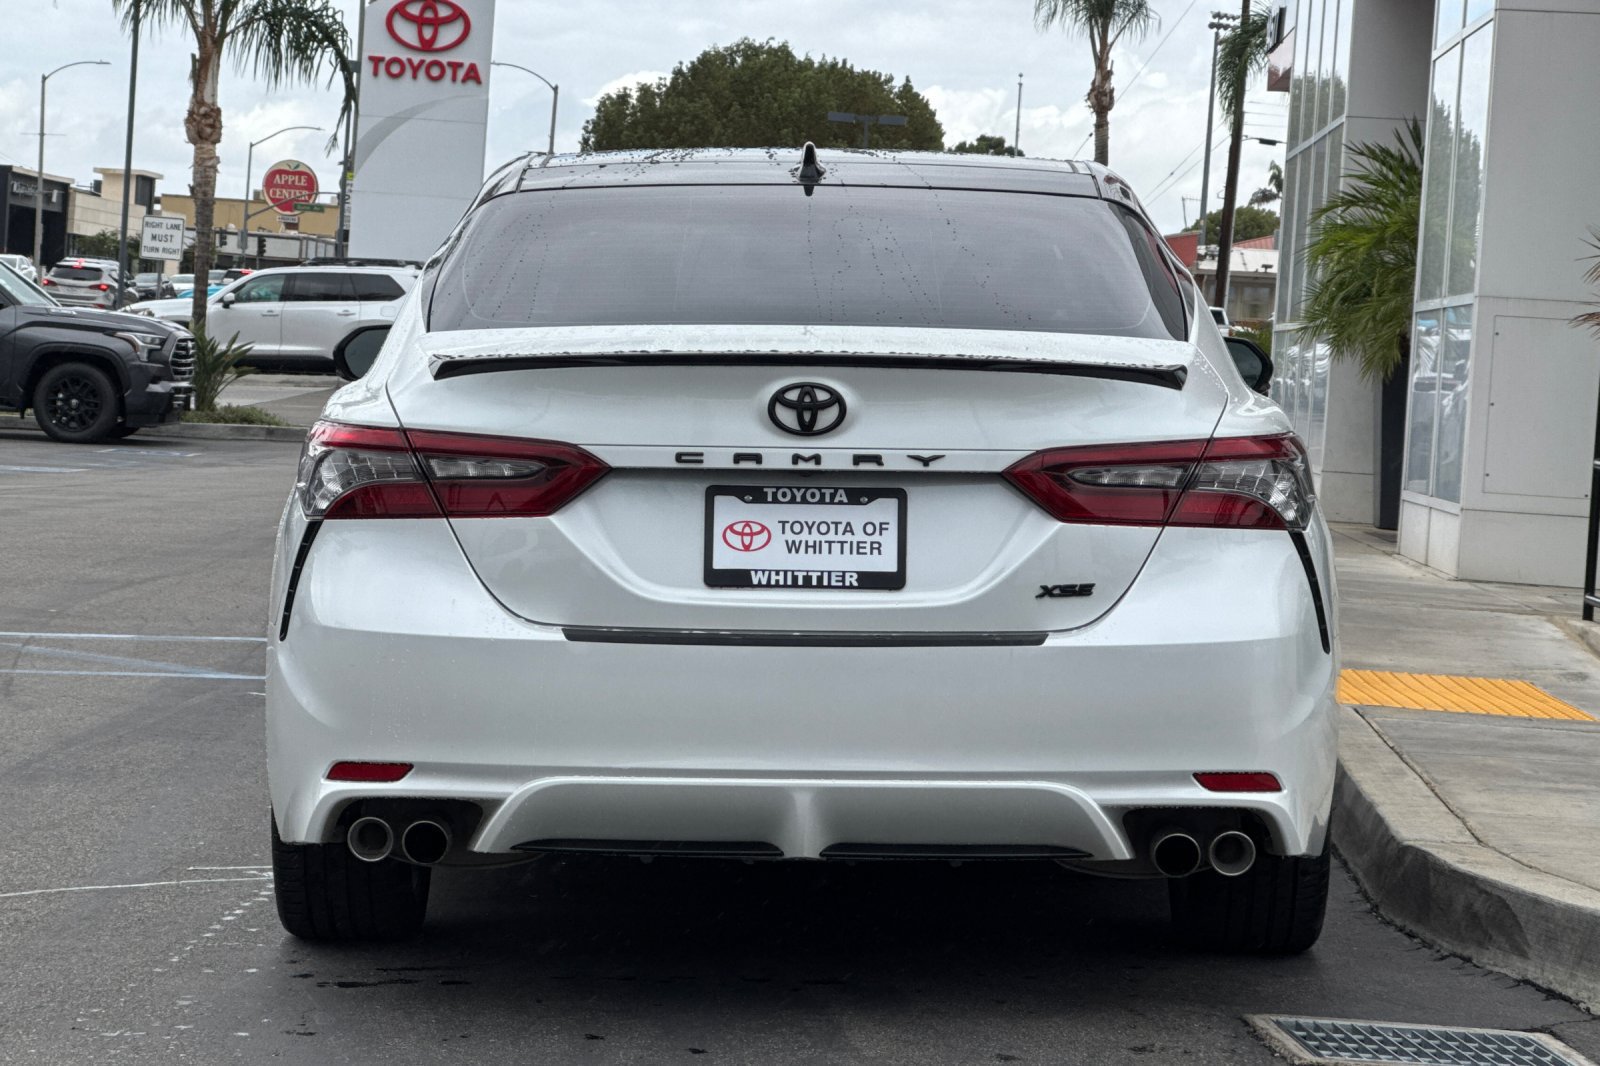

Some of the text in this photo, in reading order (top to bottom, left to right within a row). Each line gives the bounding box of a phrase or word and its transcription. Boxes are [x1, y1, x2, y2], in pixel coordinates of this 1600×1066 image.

[368, 55, 482, 85] TOYOTA
[273, 174, 308, 186] APPLE
[269, 187, 309, 201] CENTER
[145, 221, 181, 231] RIGHT LANE
[151, 233, 174, 243] MUST
[143, 245, 180, 256] TURN RIGHT
[675, 451, 946, 467] CAMRY
[763, 487, 848, 503] TOYOTA
[778, 520, 889, 536] TOYOTA OF
[785, 540, 882, 555] WHITTIER
[751, 570, 859, 587] WHITTIER
[1035, 583, 1096, 599] XSE
